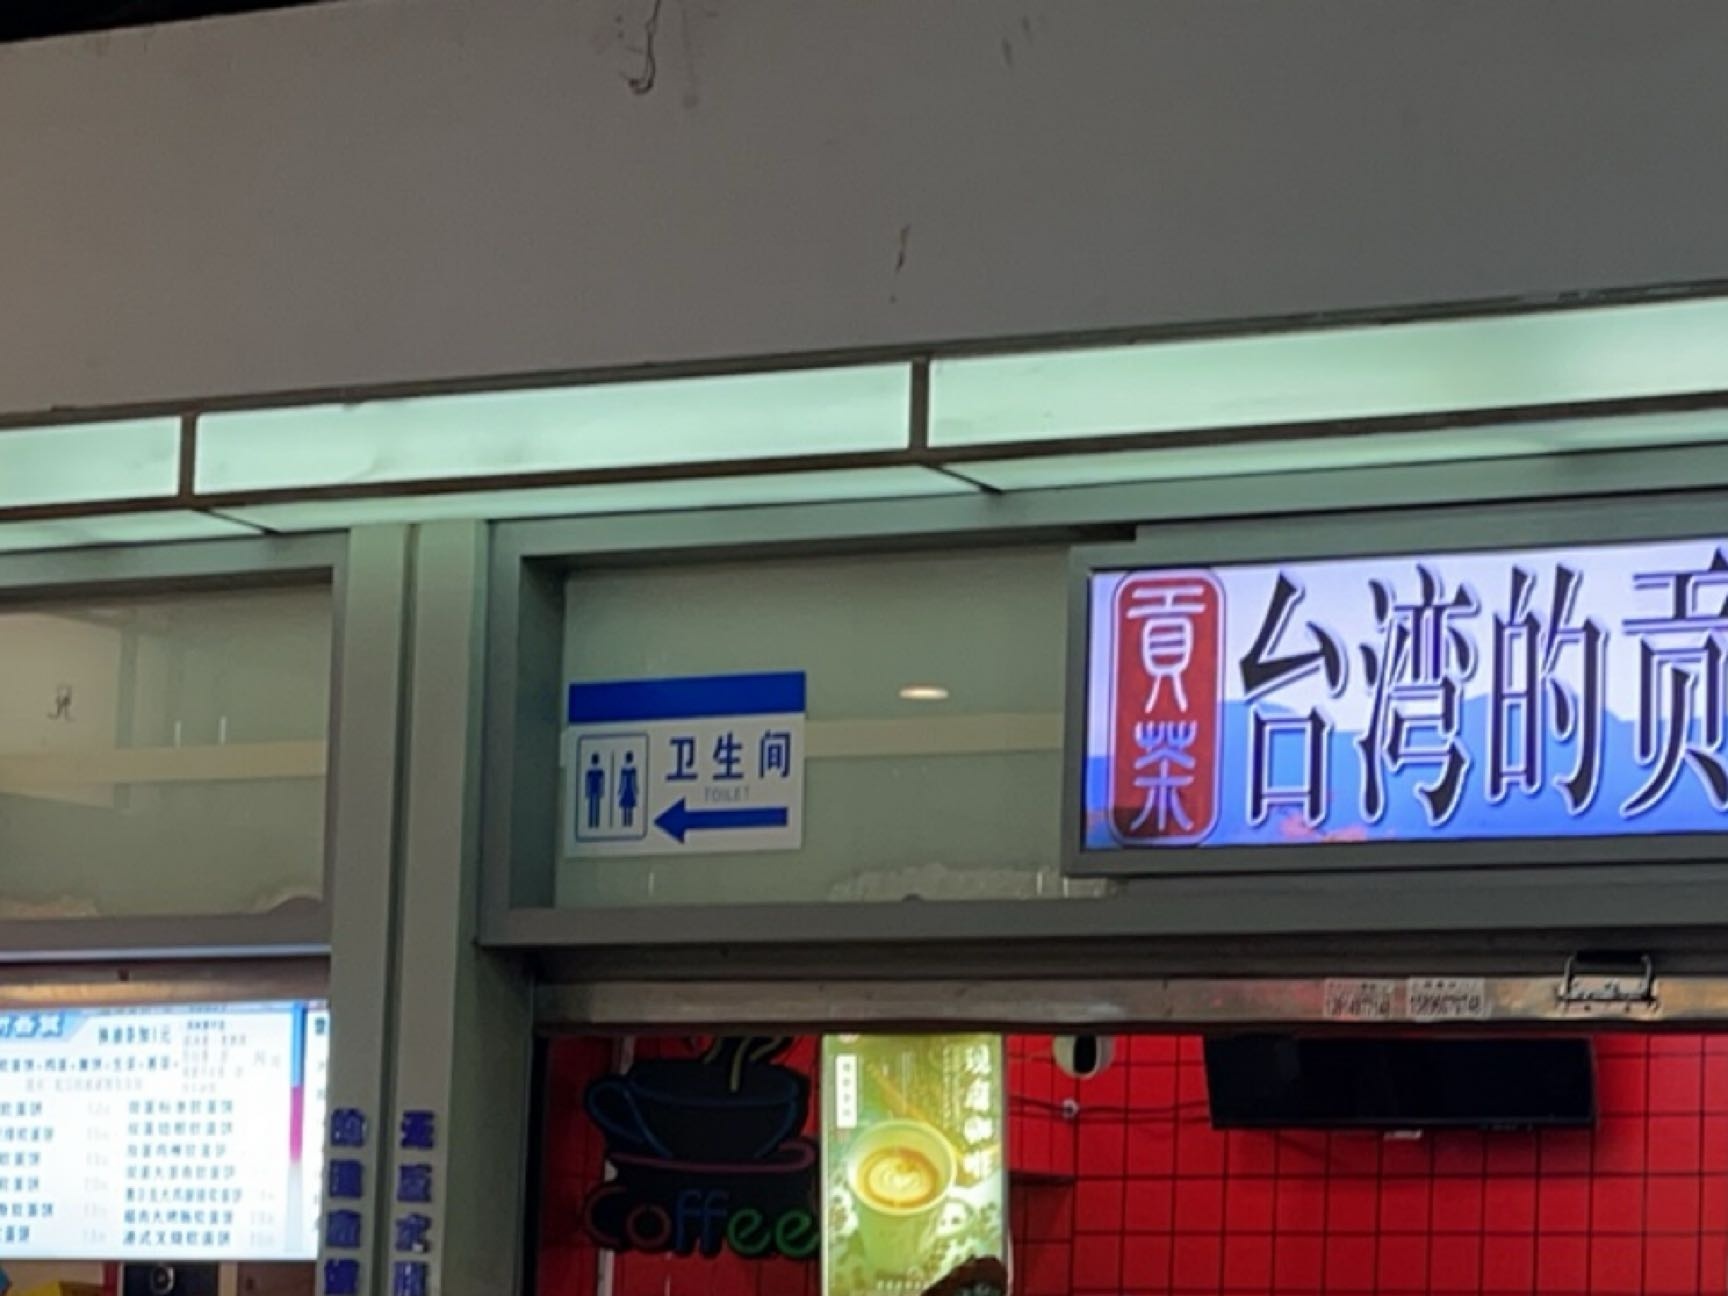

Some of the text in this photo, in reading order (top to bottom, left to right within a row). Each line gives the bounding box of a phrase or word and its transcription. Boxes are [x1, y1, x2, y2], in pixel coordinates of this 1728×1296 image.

[664, 729, 792, 783] 卫生间
[586, 1184, 818, 1258] Coffee
